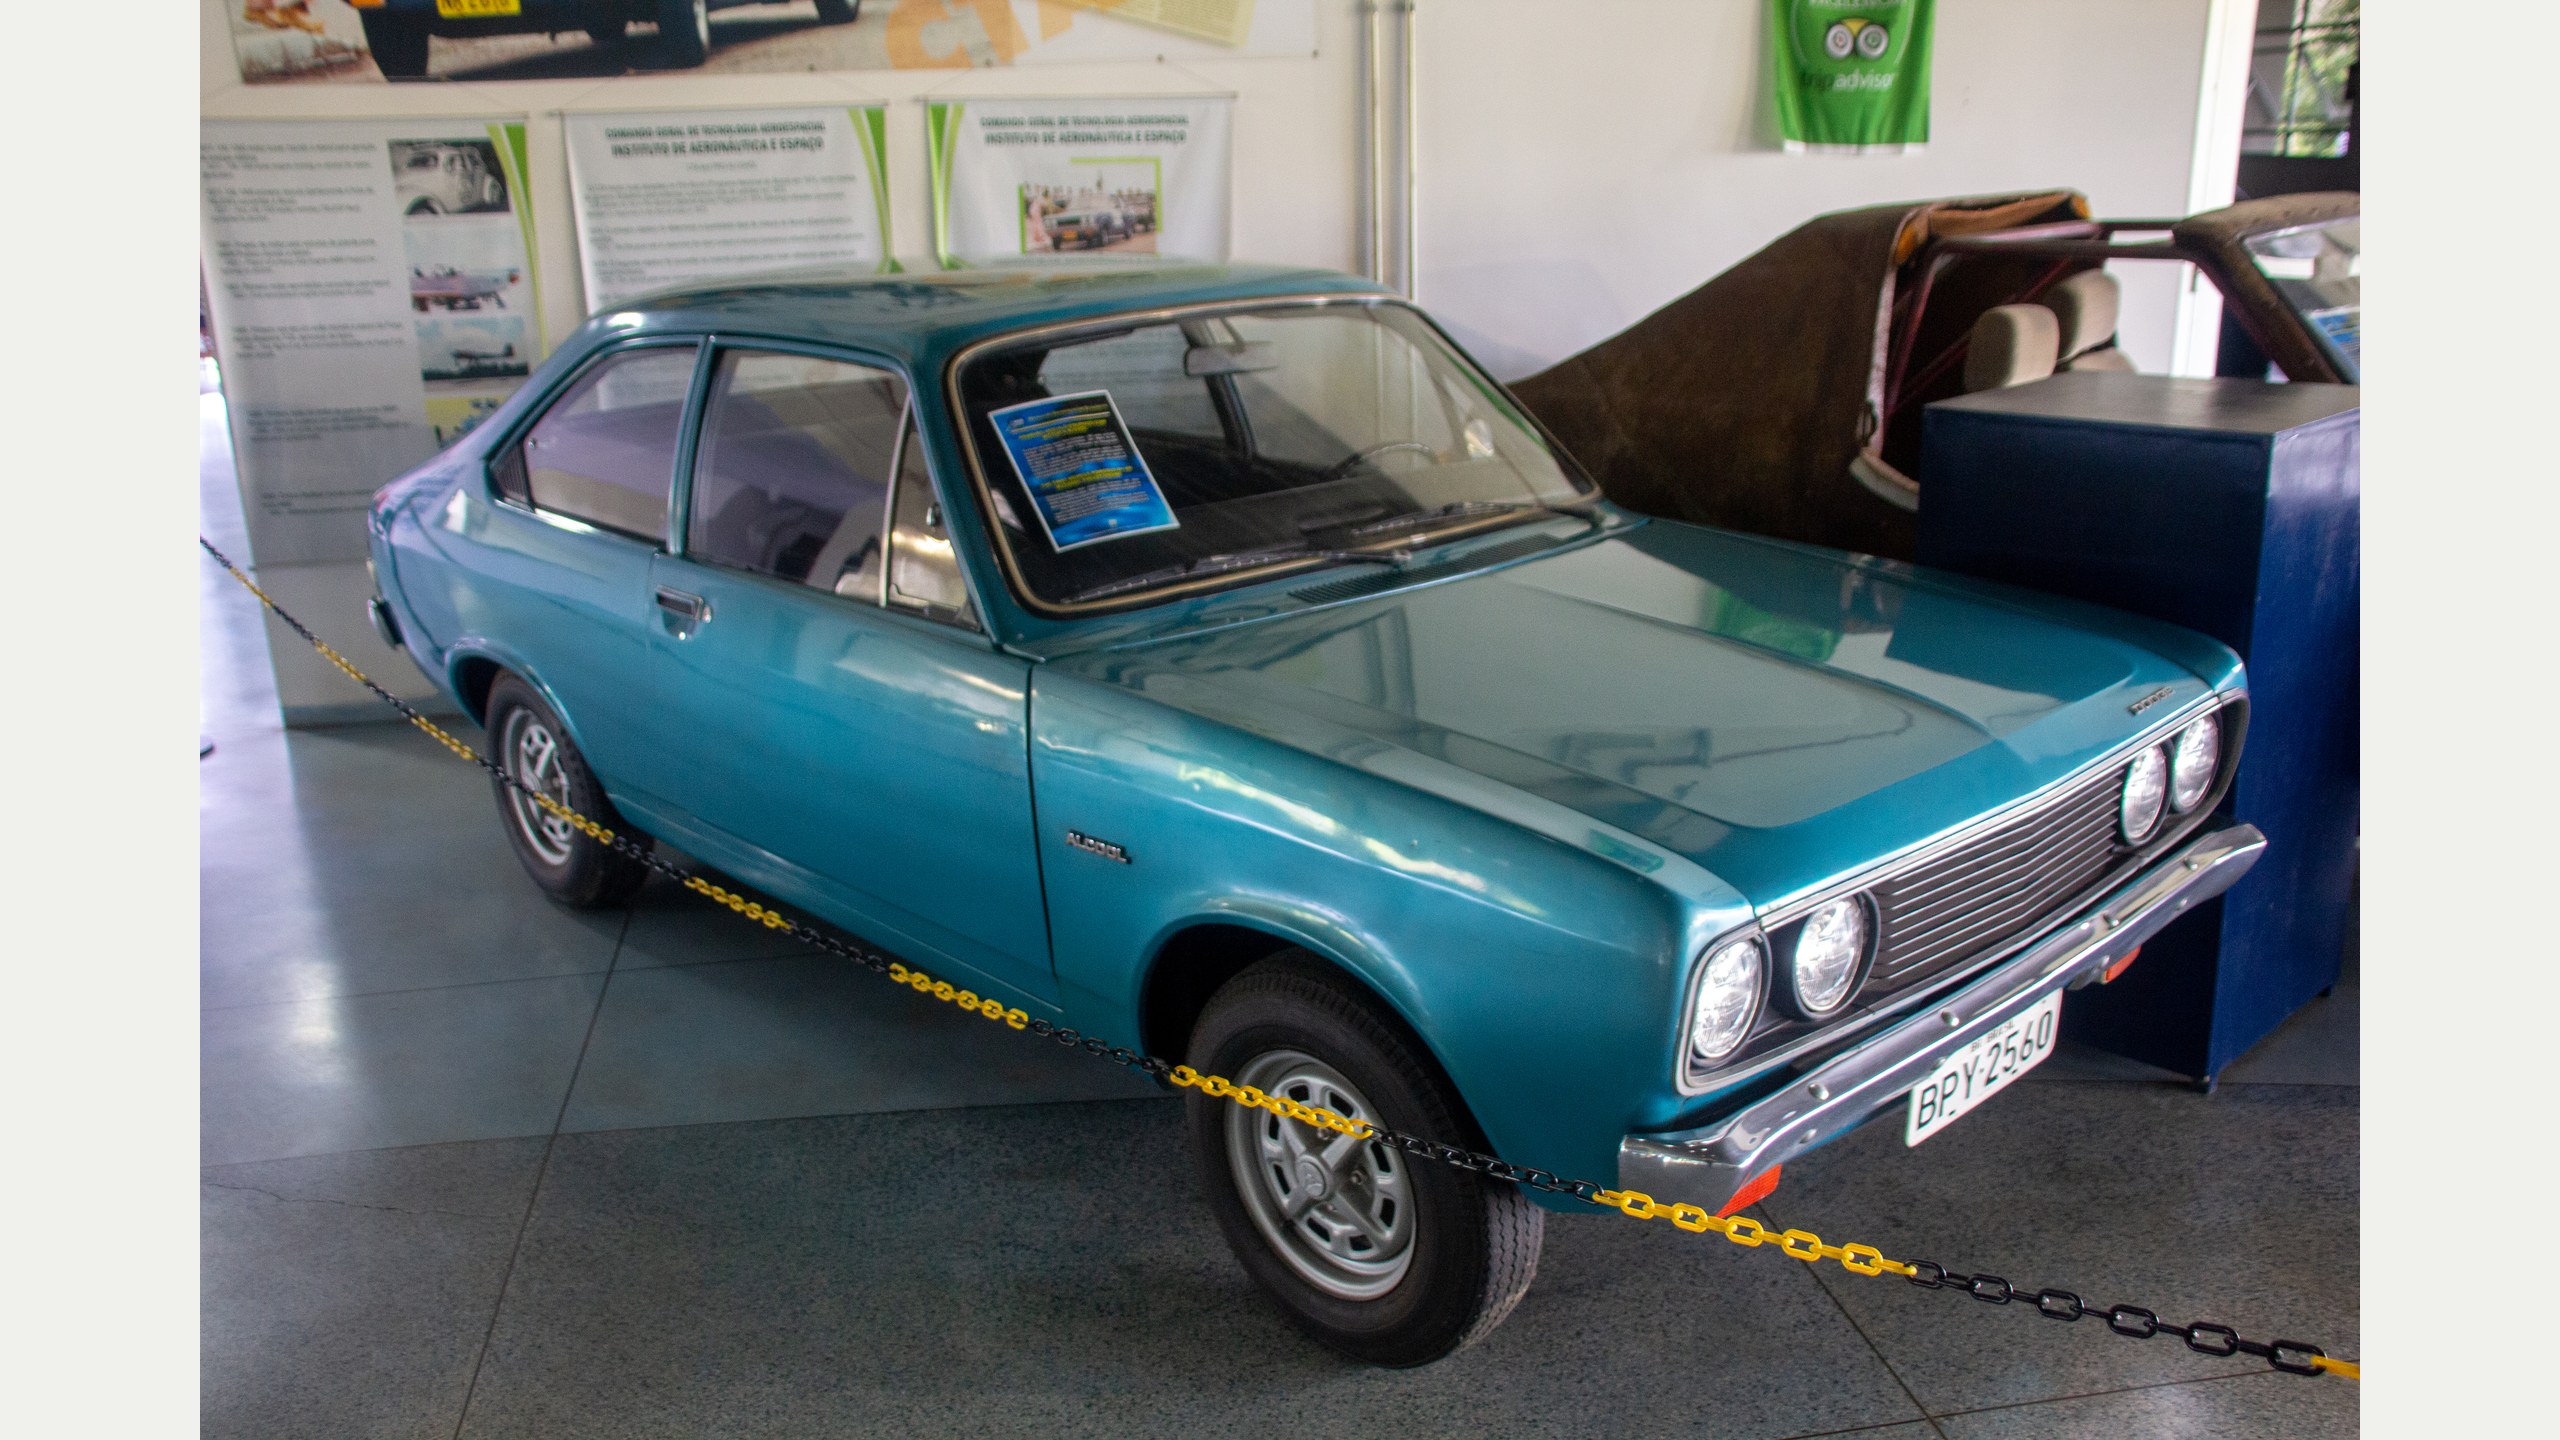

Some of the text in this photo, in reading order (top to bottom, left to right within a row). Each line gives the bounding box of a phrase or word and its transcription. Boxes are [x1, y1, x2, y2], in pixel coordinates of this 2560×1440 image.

[1042, 131, 1057, 144] DE
[1135, 130, 1142, 142] E
[671, 141, 686, 154] DE
[770, 138, 777, 150] E
